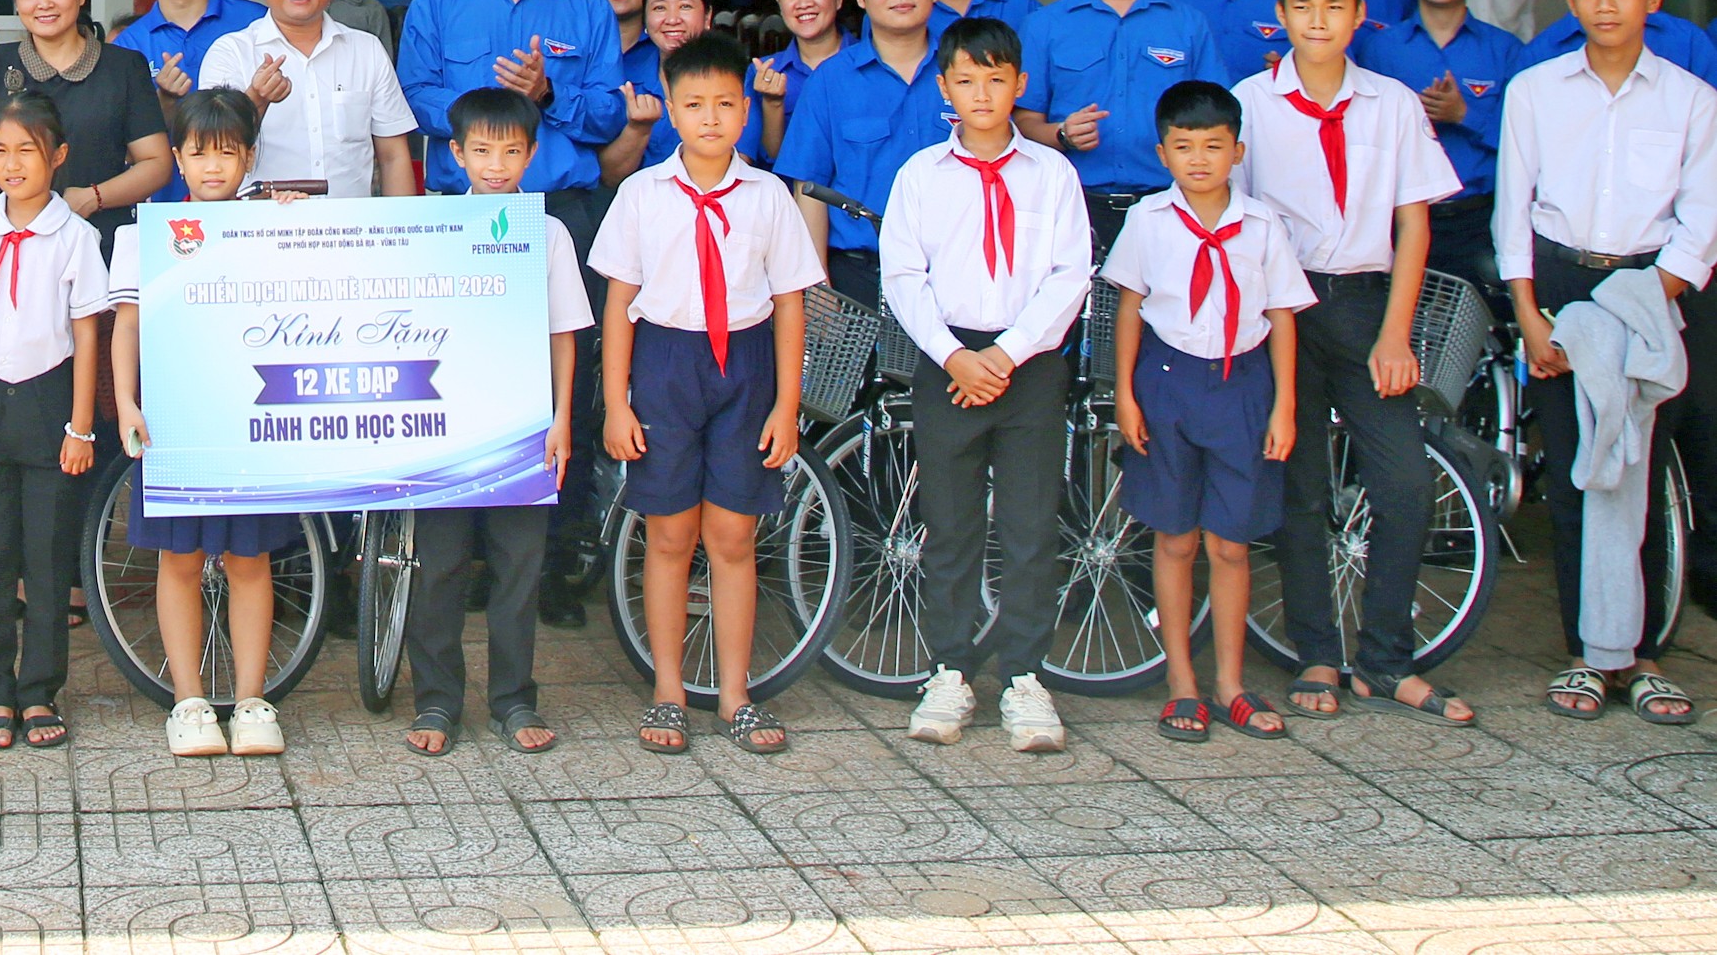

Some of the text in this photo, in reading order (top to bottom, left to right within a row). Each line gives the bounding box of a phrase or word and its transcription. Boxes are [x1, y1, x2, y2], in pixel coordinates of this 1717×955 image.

[240, 230, 254, 238] TNCS
[266, 228, 275, 237] CHÍ
[295, 228, 305, 237] TẬP
[325, 226, 340, 235] CÔNG
[342, 226, 363, 236] NGHIỆP
[369, 225, 384, 234] NĂNG
[386, 226, 405, 236] LƯỢNG
[407, 224, 422, 234] QUỐC
[436, 224, 447, 234] VIỆT
[449, 224, 463, 232] NAM
[322, 240, 336, 249] HOẠT
[472, 243, 530, 254] PETROVIETNAM
[184, 273, 506, 307] CHIẾN DỊCH MÙA HÈ XANH NĂM 2026
[243, 309, 450, 356] Kính Tặng
[293, 366, 399, 399] 12 XE ĐẠP
[249, 412, 446, 444] DÀNH CHO HỌC SINH
